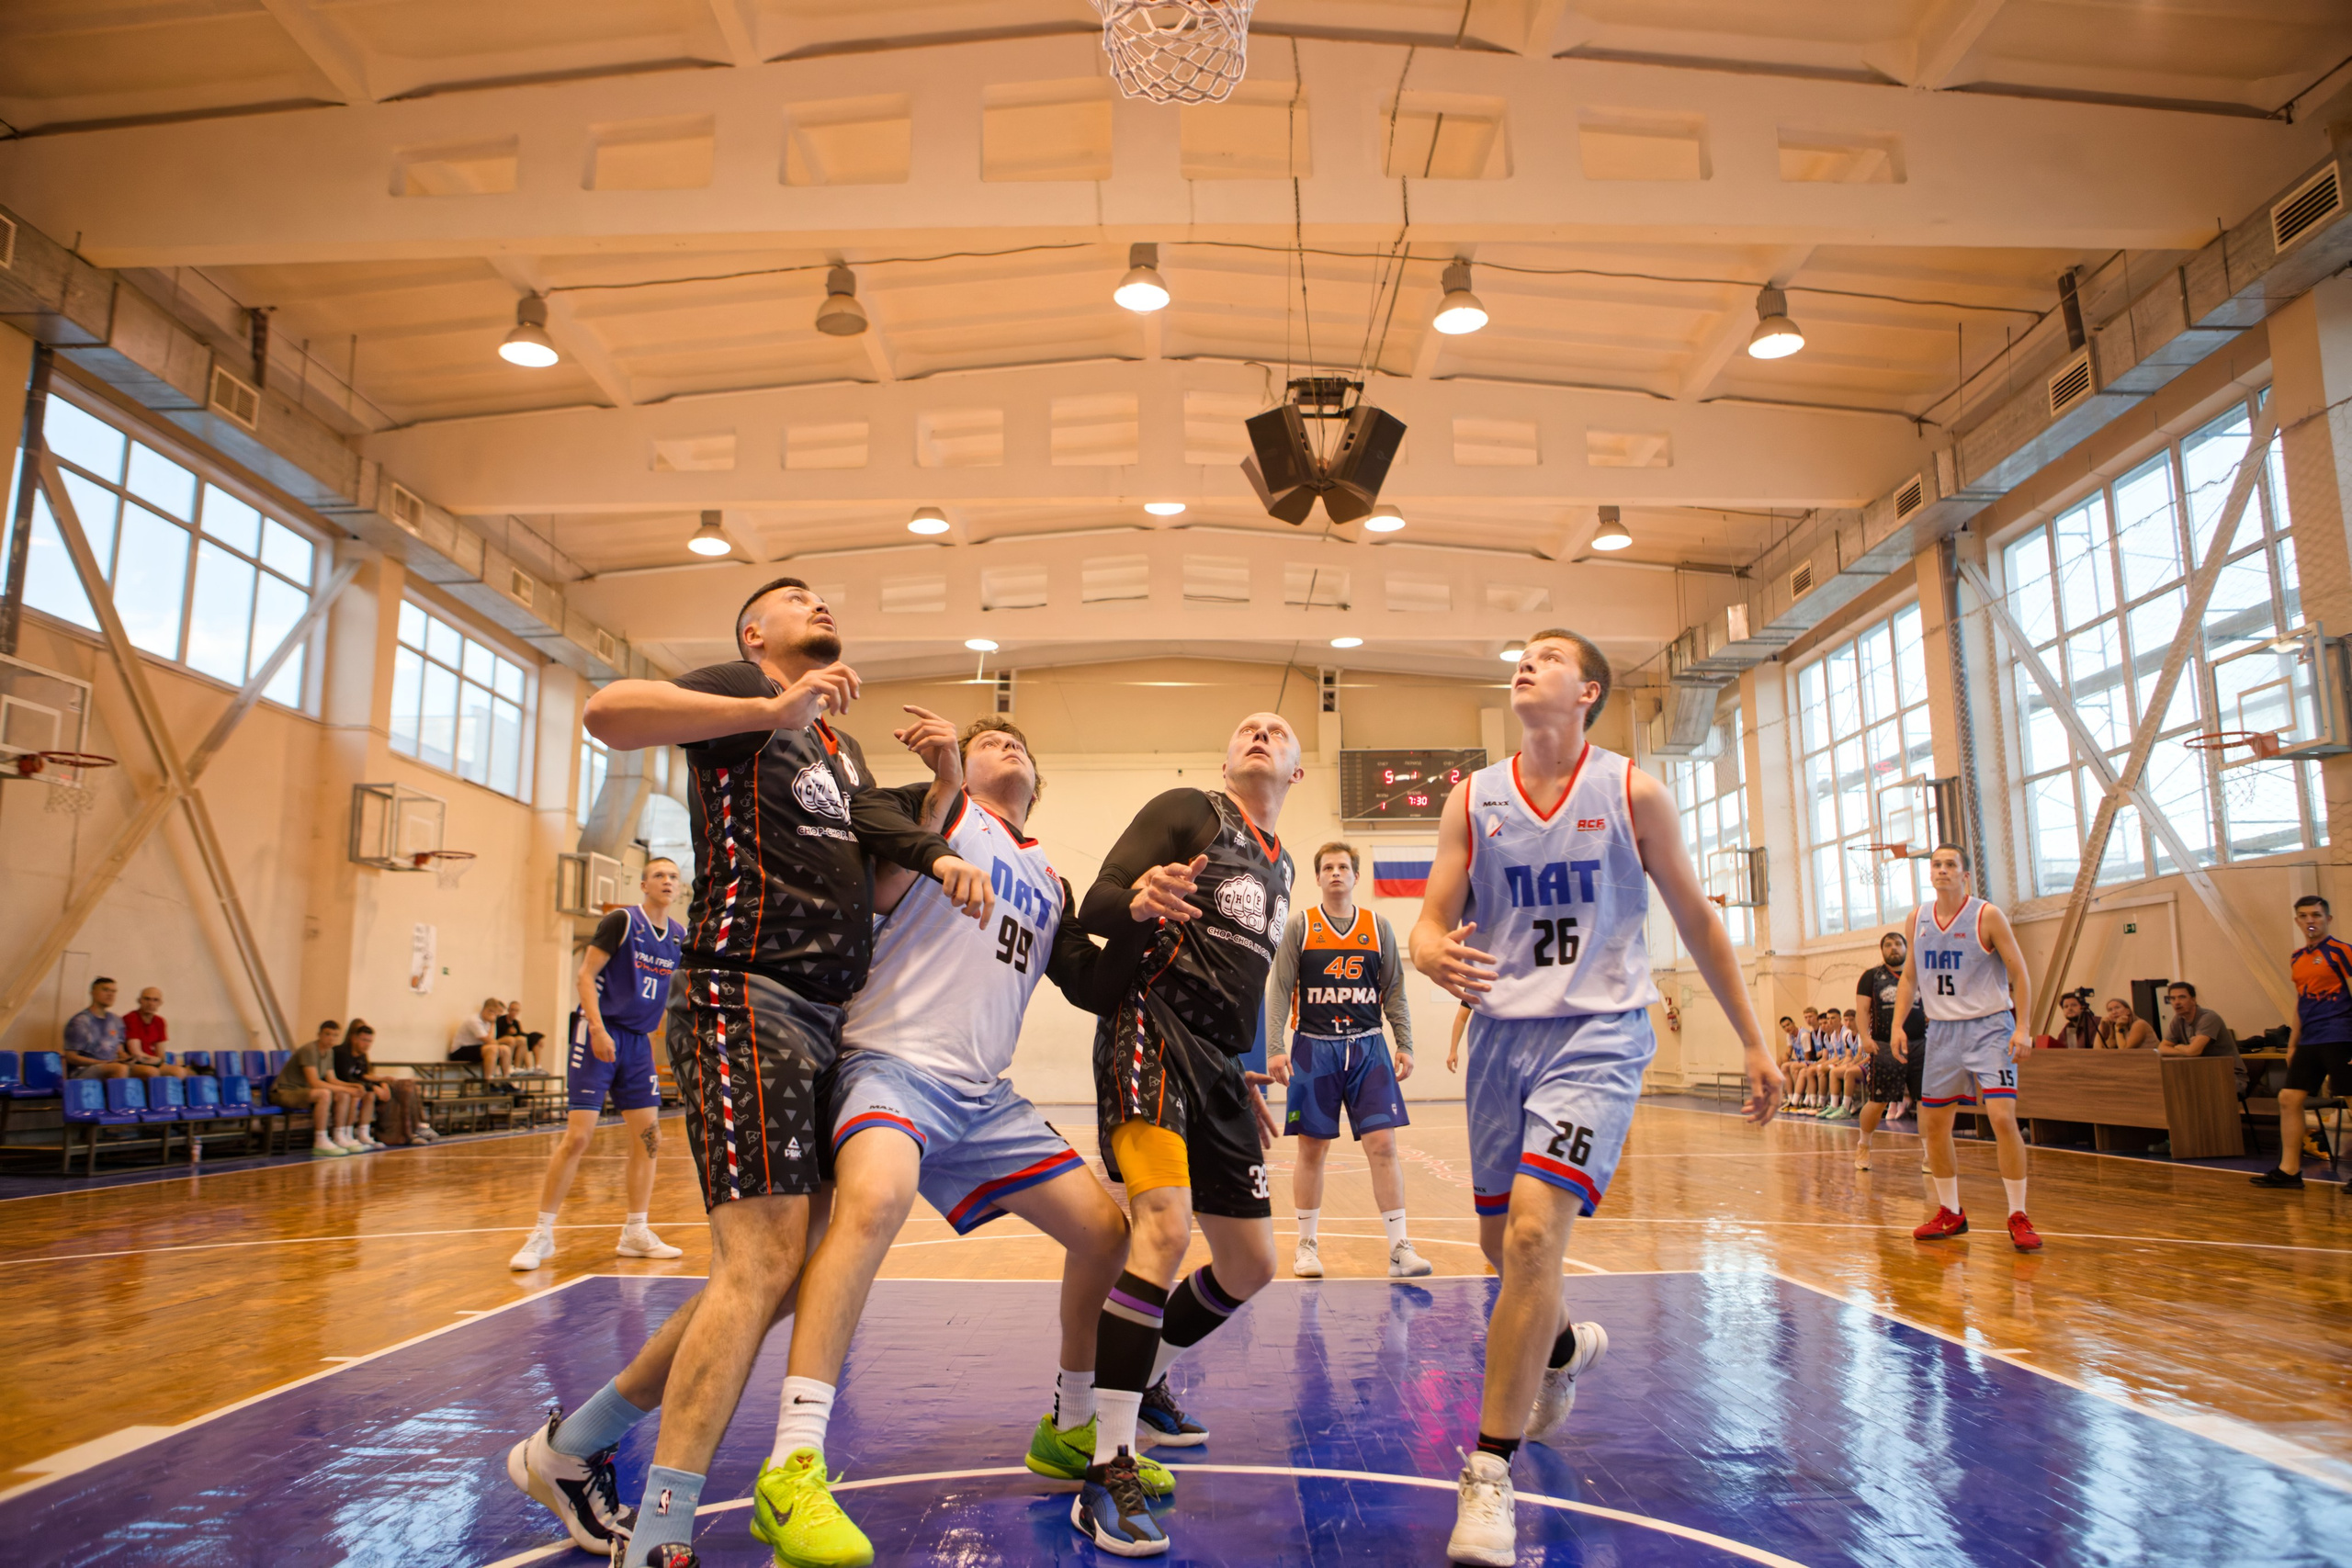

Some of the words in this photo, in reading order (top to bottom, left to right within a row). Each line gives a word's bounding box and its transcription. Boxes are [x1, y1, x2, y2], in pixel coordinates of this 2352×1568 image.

[1451, 769, 1460, 784] 2
[1408, 796, 1428, 807] 7:30
[990, 855, 1053, 931] ПАТ
[1504, 860, 1601, 908] ПАТ
[1225, 894, 1262, 905] CHOP
[995, 914, 1035, 975] 99
[1532, 917, 1579, 967] 26
[1323, 955, 1365, 980] 46
[1924, 951, 1963, 970] ПАТ
[641, 976, 658, 1000] 21
[1306, 987, 1377, 1005] ПАРМА
[1937, 975, 1956, 997] 15
[1997, 1069, 2016, 1087] 15
[868, 1104, 901, 1114] MAXX
[1546, 1119, 1594, 1168] 26
